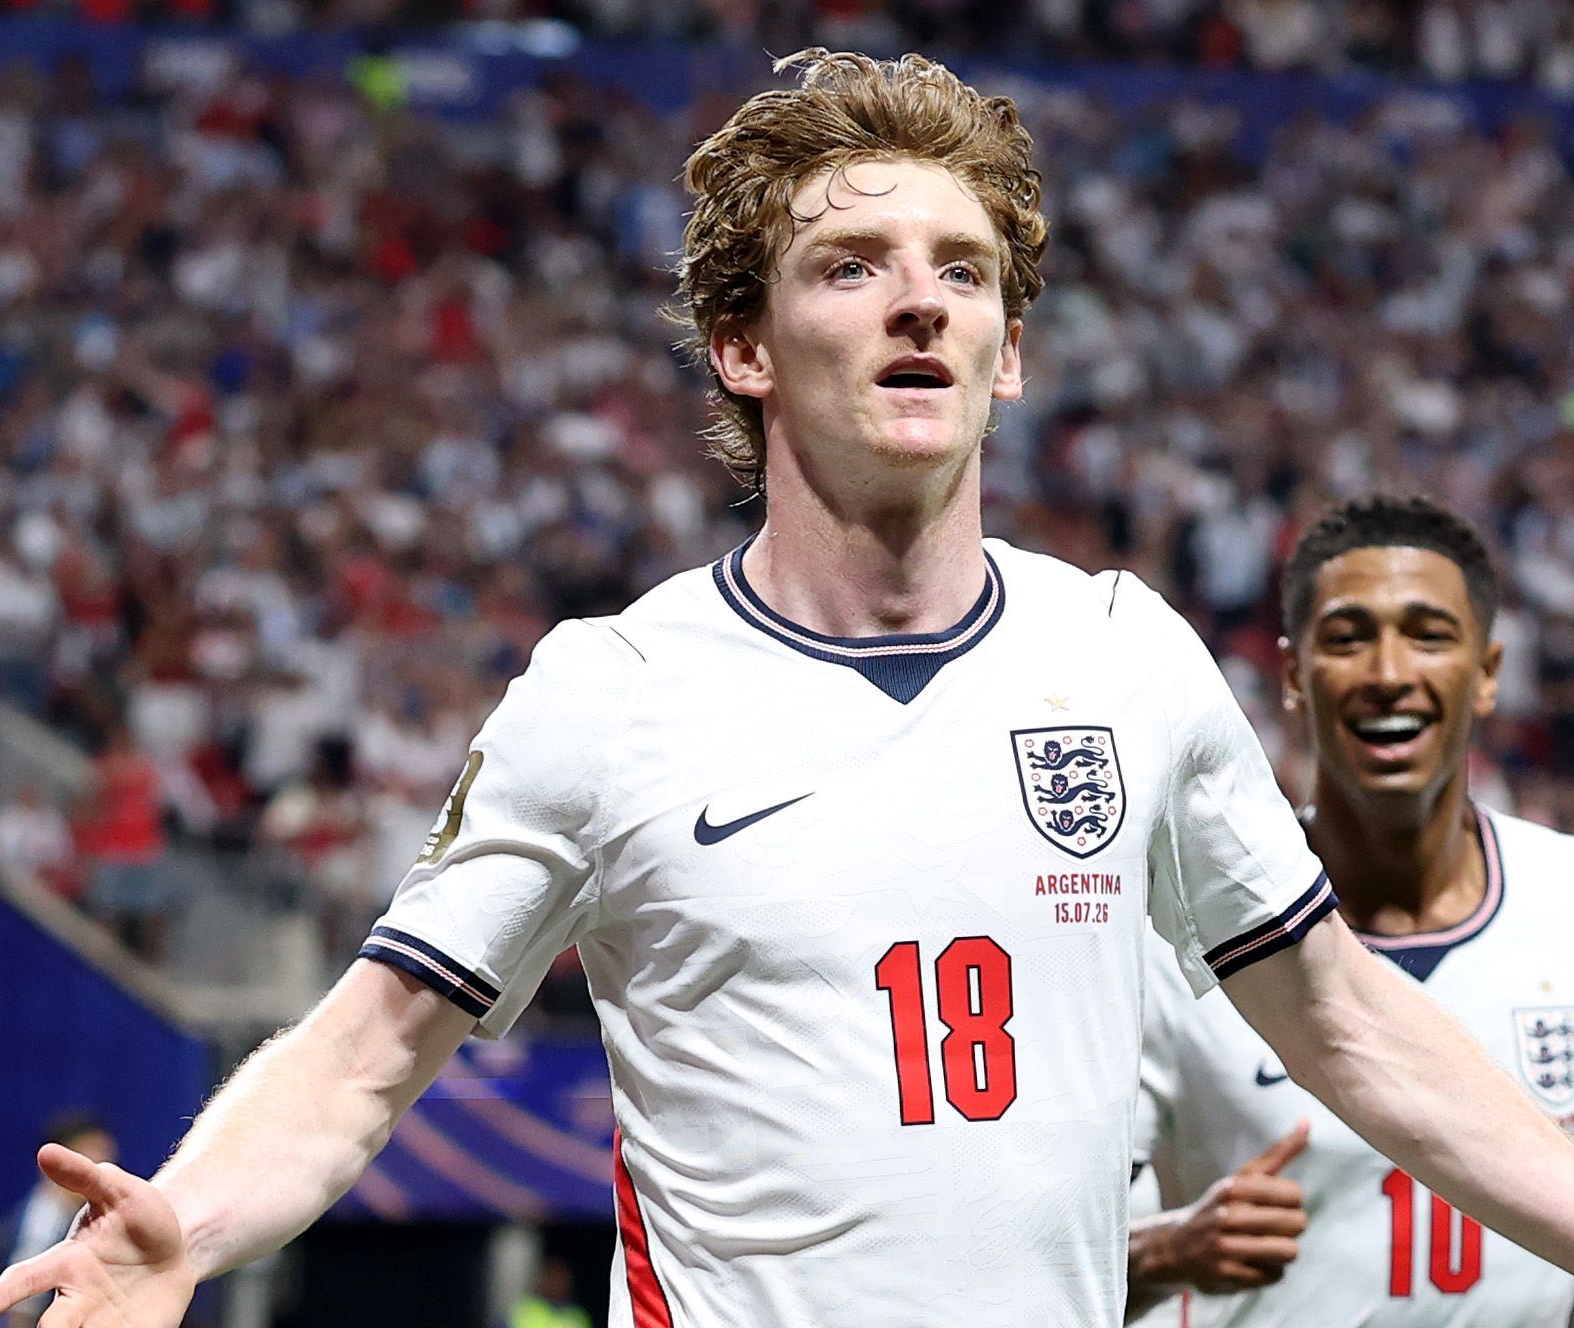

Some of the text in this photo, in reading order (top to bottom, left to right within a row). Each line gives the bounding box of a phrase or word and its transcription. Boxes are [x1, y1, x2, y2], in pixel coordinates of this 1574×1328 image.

[1035, 874, 1121, 896] ARGENTINA
[1054, 902, 1109, 924] 15.07.26
[875, 936, 1017, 1126] 18
[1382, 1167, 1484, 1298] 10
